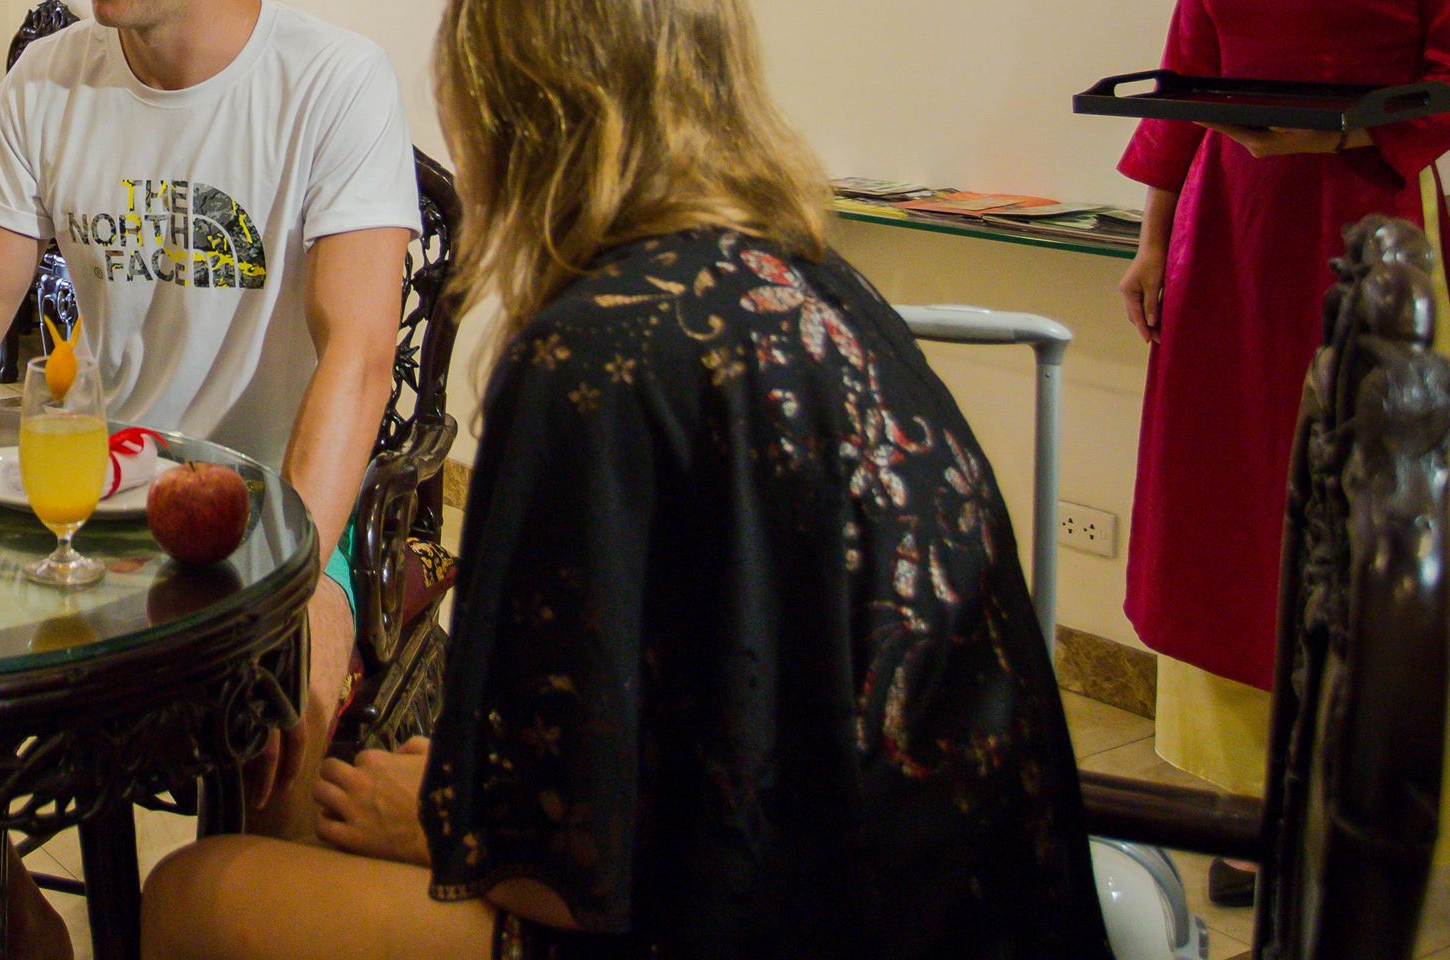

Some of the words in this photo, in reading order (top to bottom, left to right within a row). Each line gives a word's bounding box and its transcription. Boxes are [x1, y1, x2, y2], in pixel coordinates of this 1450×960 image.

[121, 179, 189, 214] THE
[67, 211, 189, 249] NORTH
[104, 247, 190, 287] FACE
